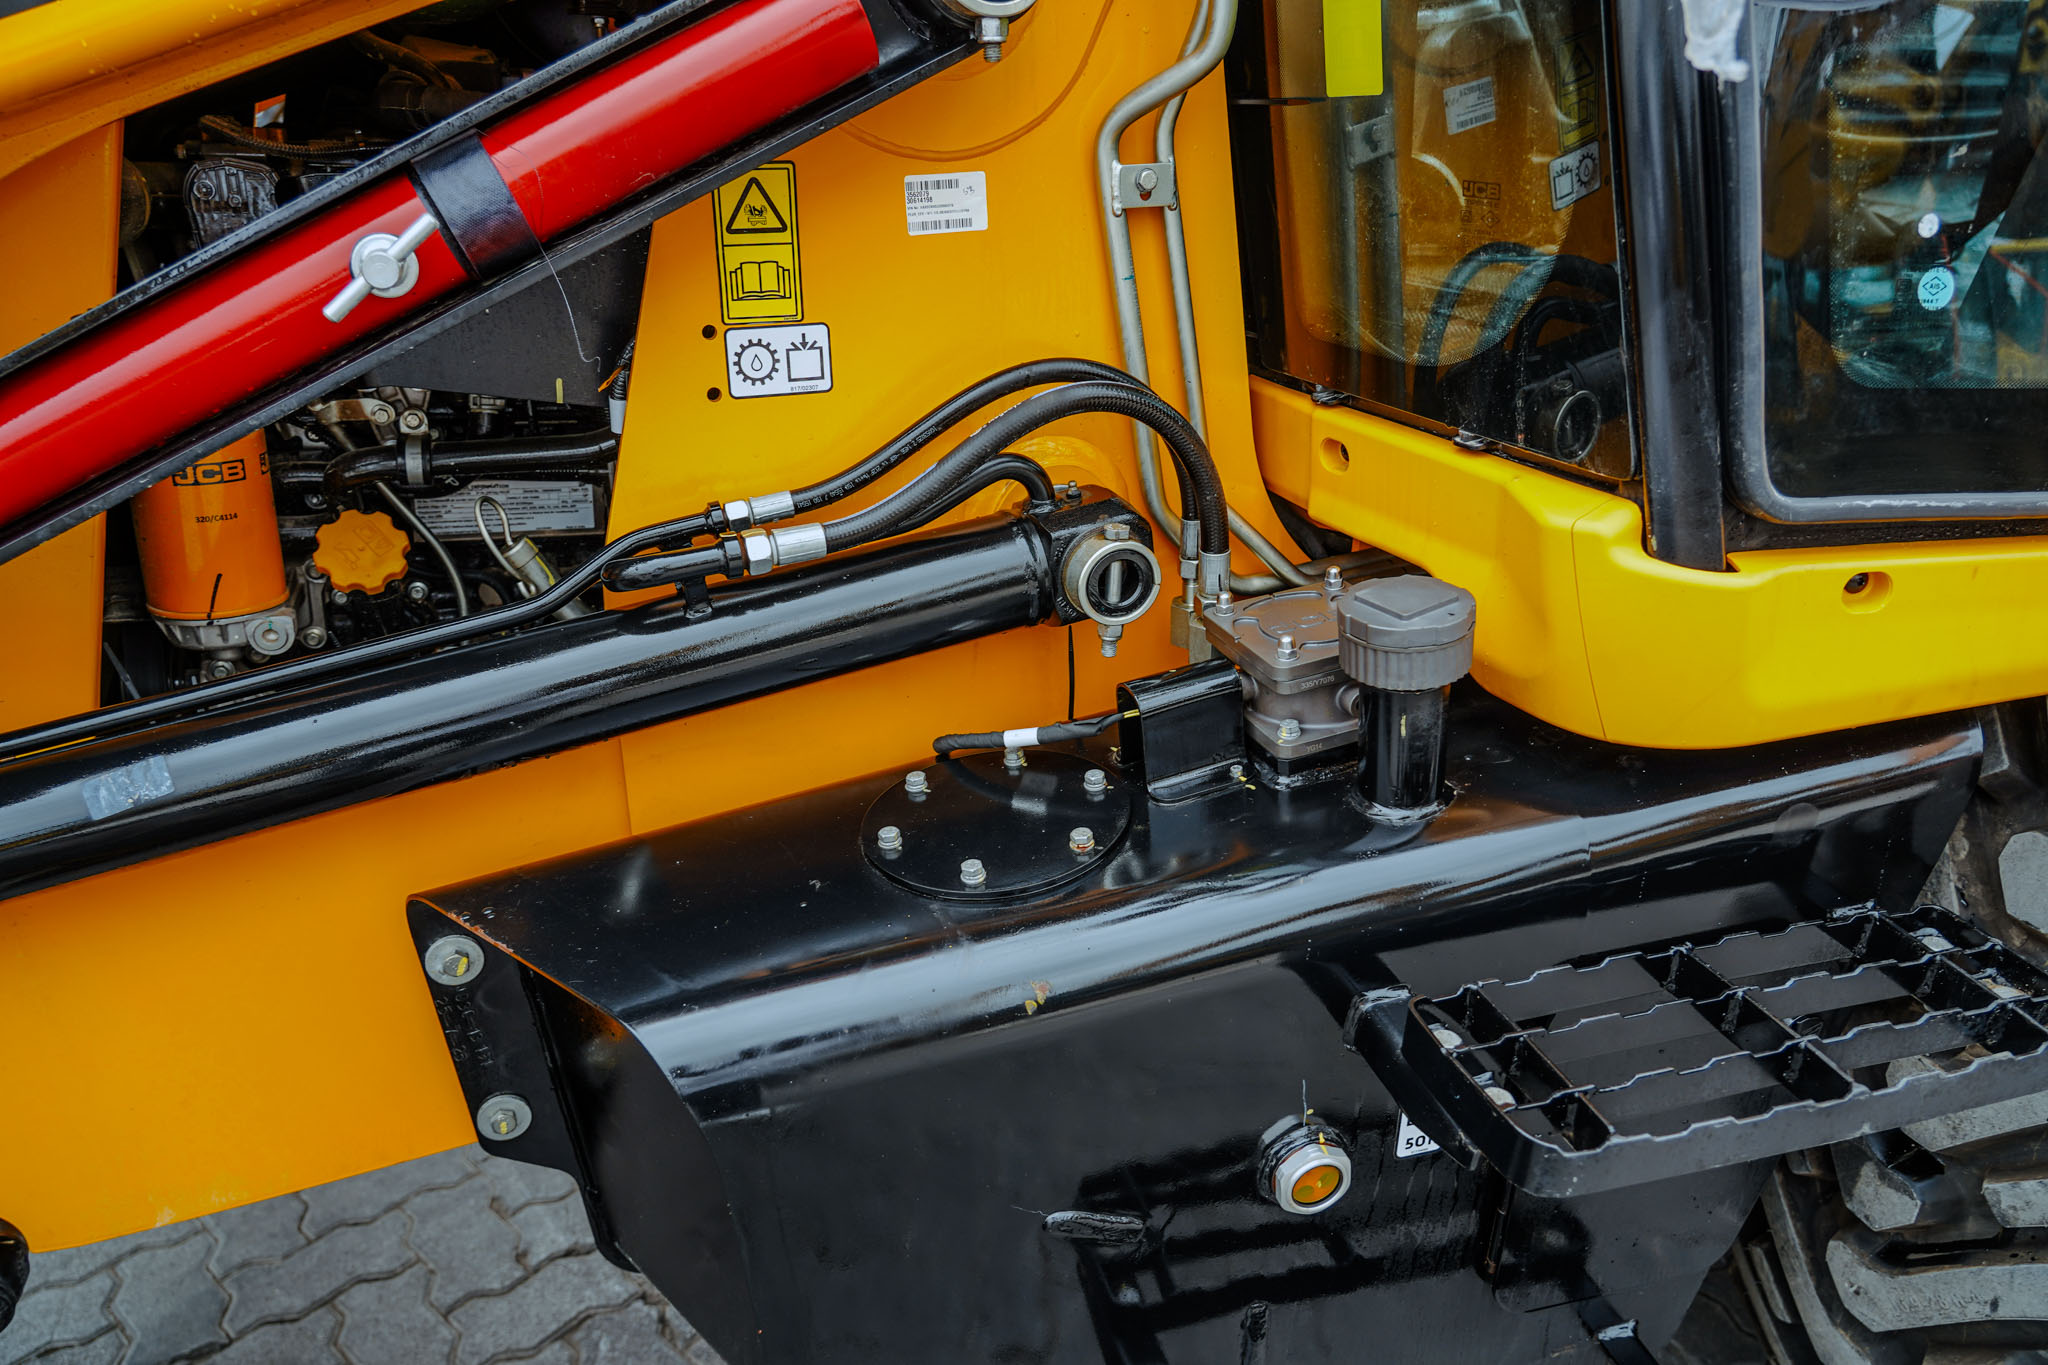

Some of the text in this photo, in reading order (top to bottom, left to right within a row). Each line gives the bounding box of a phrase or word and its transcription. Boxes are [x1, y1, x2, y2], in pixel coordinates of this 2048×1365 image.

[1463, 180, 1500, 200] JCB
[790, 384, 820, 392] 817/02307
[174, 461, 245, 485] JCB
[195, 512, 238, 523] 320/C4114
